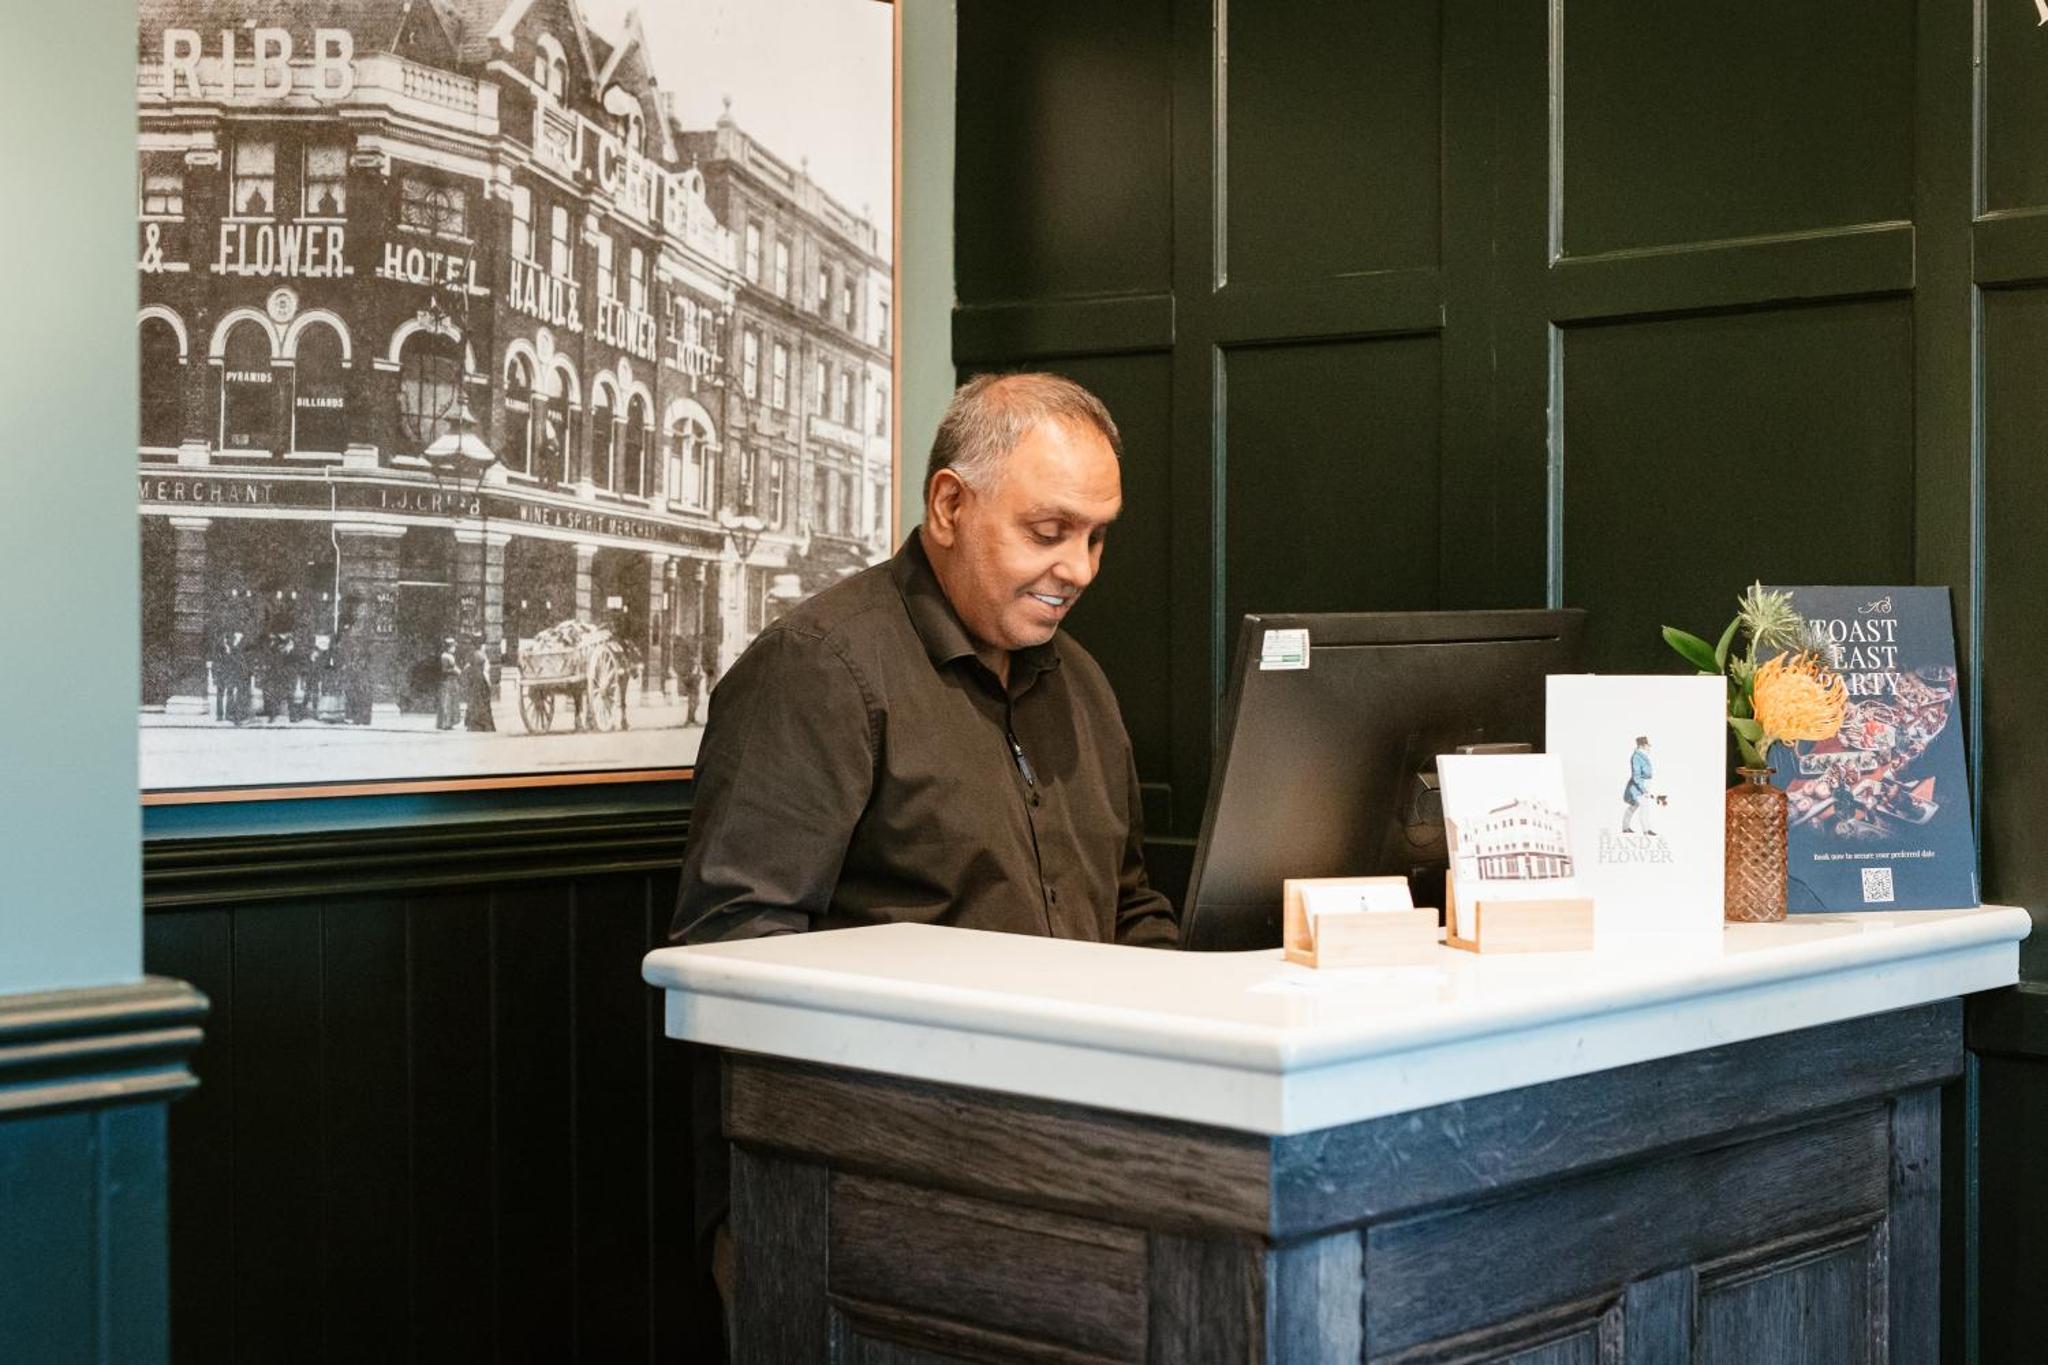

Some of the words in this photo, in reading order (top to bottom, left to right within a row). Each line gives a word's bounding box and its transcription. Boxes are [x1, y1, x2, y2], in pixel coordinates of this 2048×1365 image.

[142, 223, 164, 273] &
[219, 224, 345, 277] FLOWER
[384, 242, 491, 296] HOTEL
[509, 259, 566, 326] HAND
[567, 286, 584, 334] &
[597, 300, 657, 362] FLOWER
[226, 371, 272, 383] PYRAMIDS
[297, 397, 344, 408] BILLIARDS
[138, 481, 273, 504] MERCHANT
[519, 504, 550, 525] WINE
[567, 511, 605, 534] SPIRIT
[1809, 619, 1898, 642] TOAST
[1833, 646, 1898, 670] EAST
[1599, 835, 1652, 850] HAND
[1599, 850, 1674, 864] FLOWER
